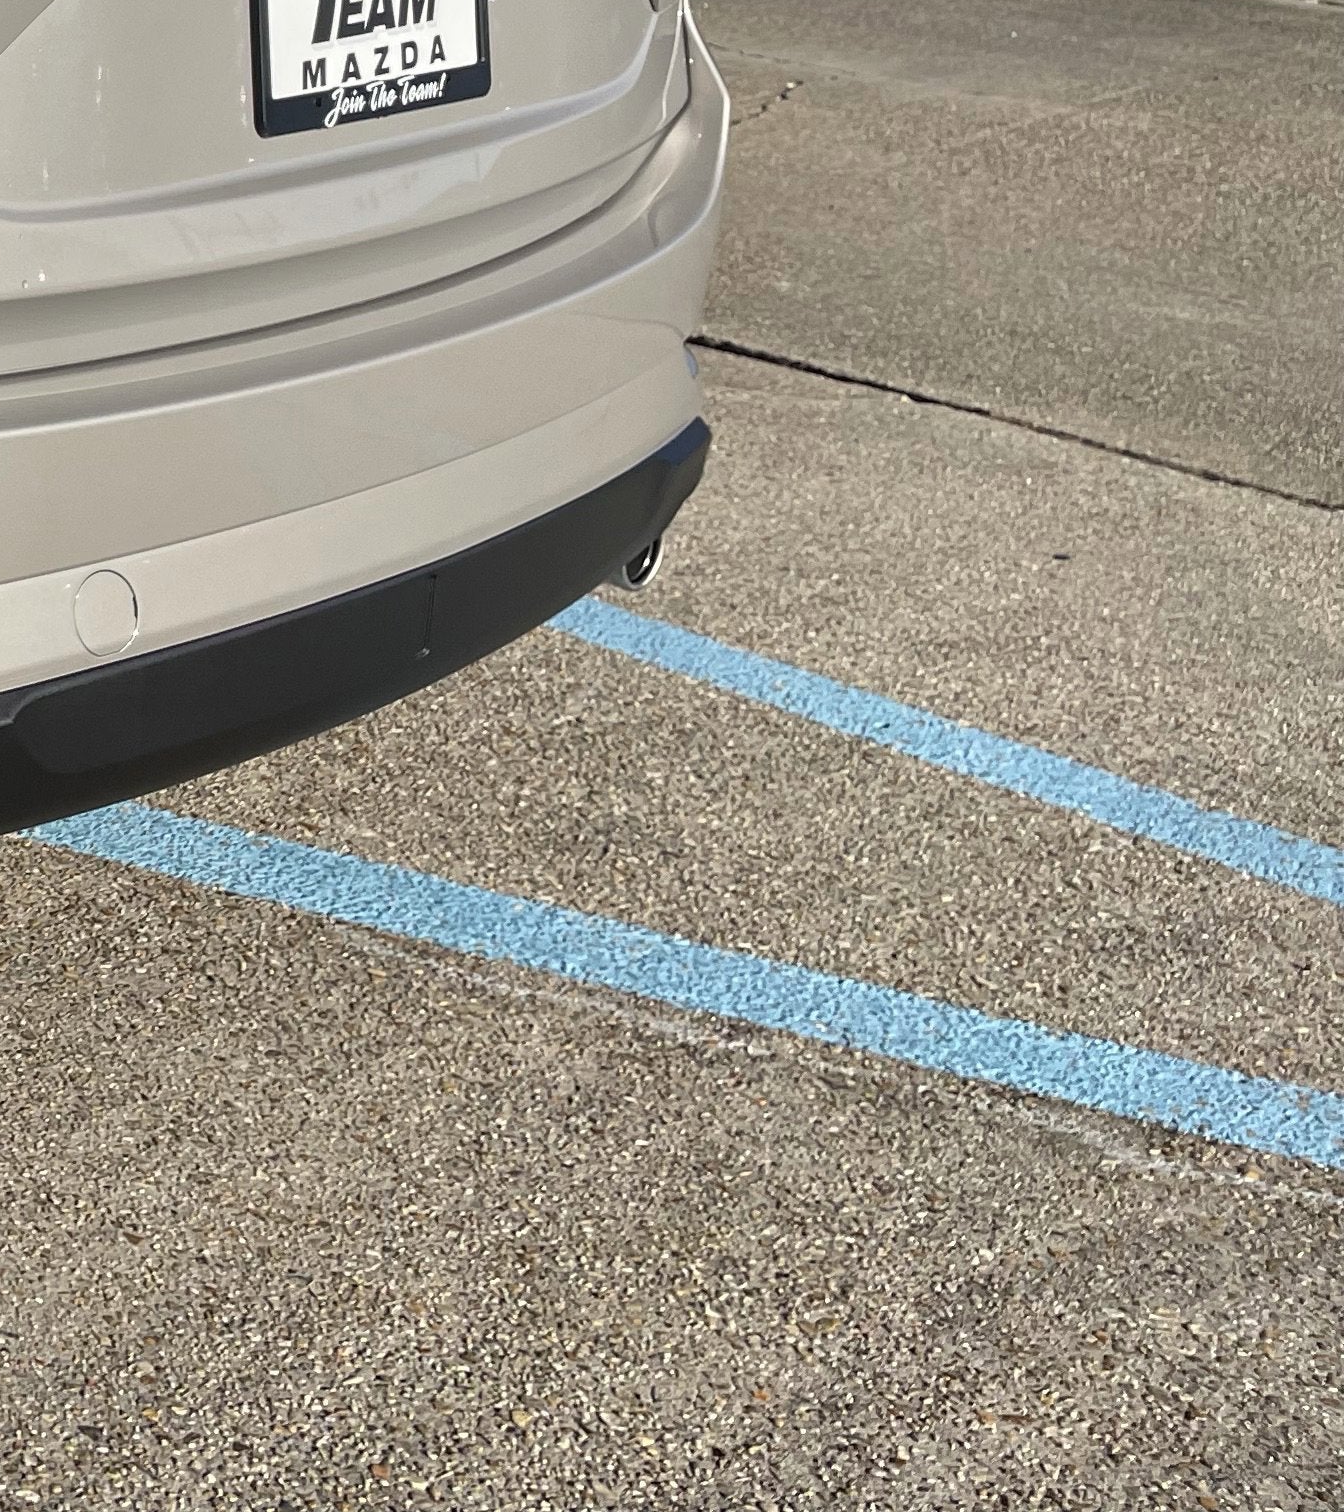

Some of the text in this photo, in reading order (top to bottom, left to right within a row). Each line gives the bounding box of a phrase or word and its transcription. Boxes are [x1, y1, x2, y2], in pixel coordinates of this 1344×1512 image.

[302, 34, 446, 90] MAZDA
[324, 72, 448, 128] Join The Team!
